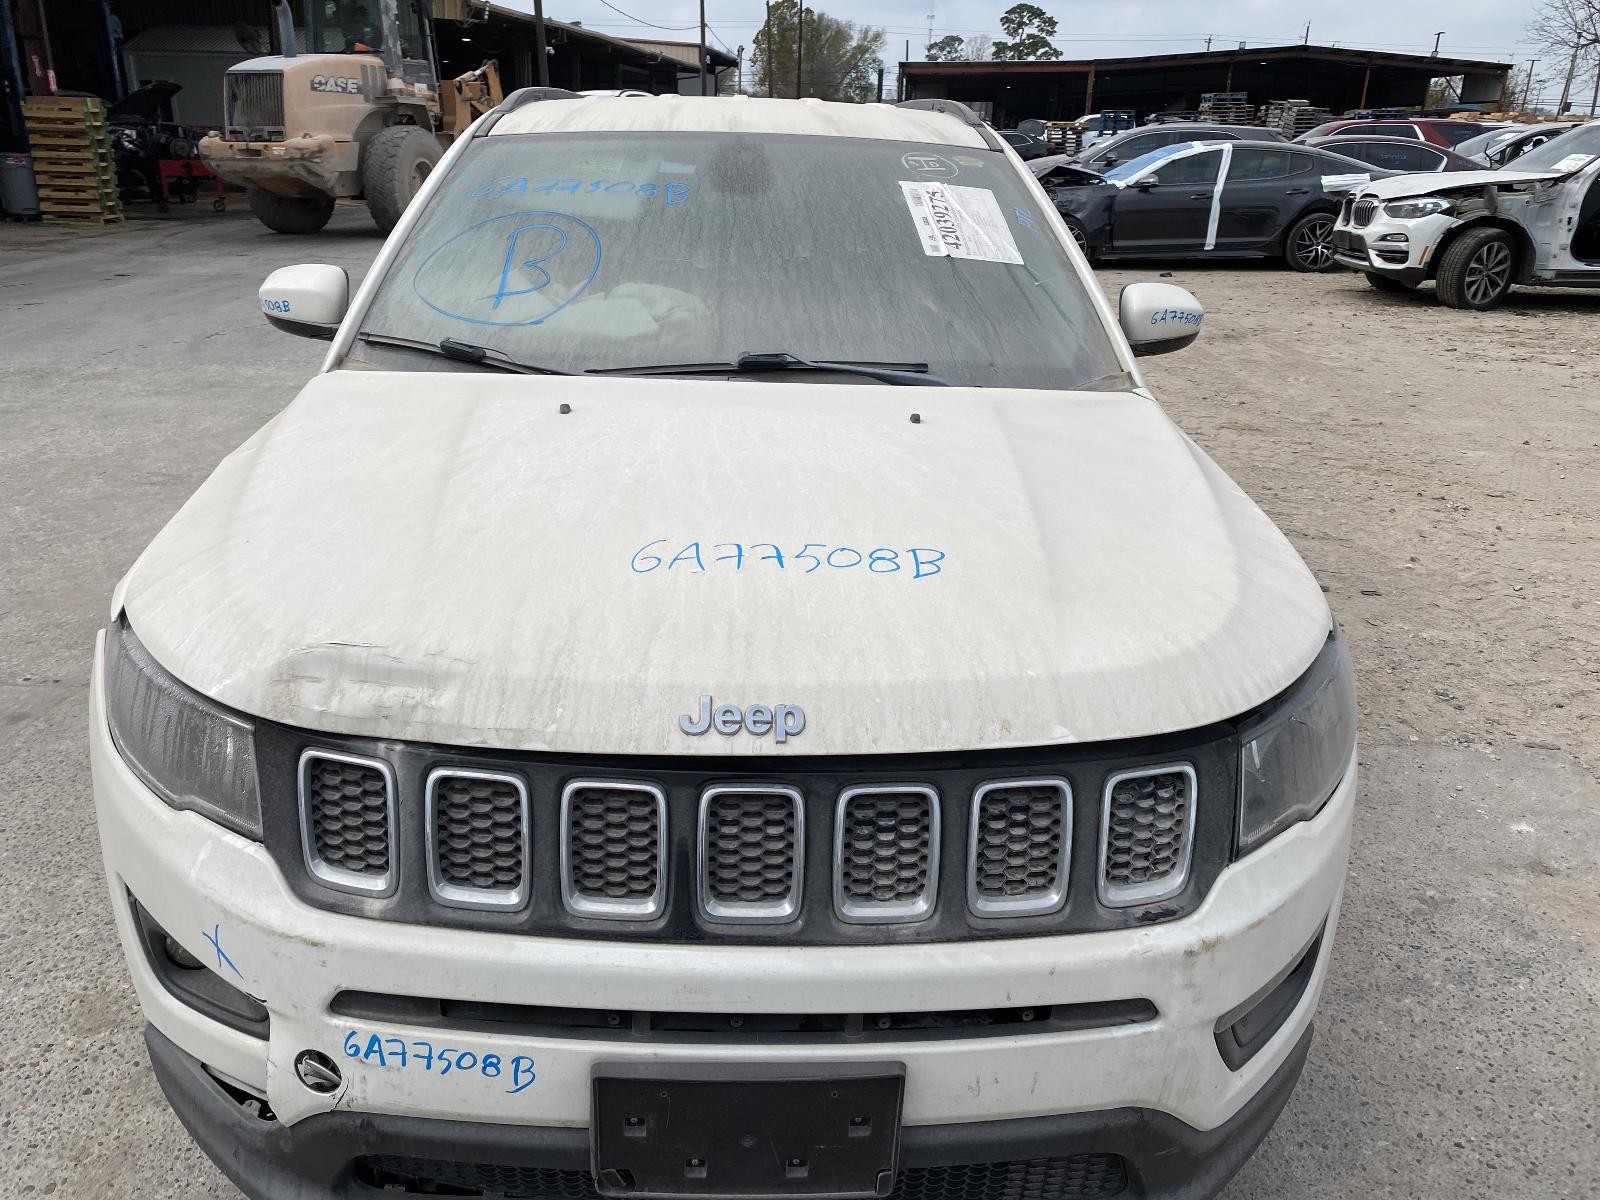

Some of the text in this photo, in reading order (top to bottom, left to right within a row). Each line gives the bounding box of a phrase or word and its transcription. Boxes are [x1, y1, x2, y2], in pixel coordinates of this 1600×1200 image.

[313, 75, 358, 93] CASE
[630, 539, 946, 578] 6A77508B
[679, 694, 807, 744] Jeep
[343, 1030, 537, 1094] 6A77508B
